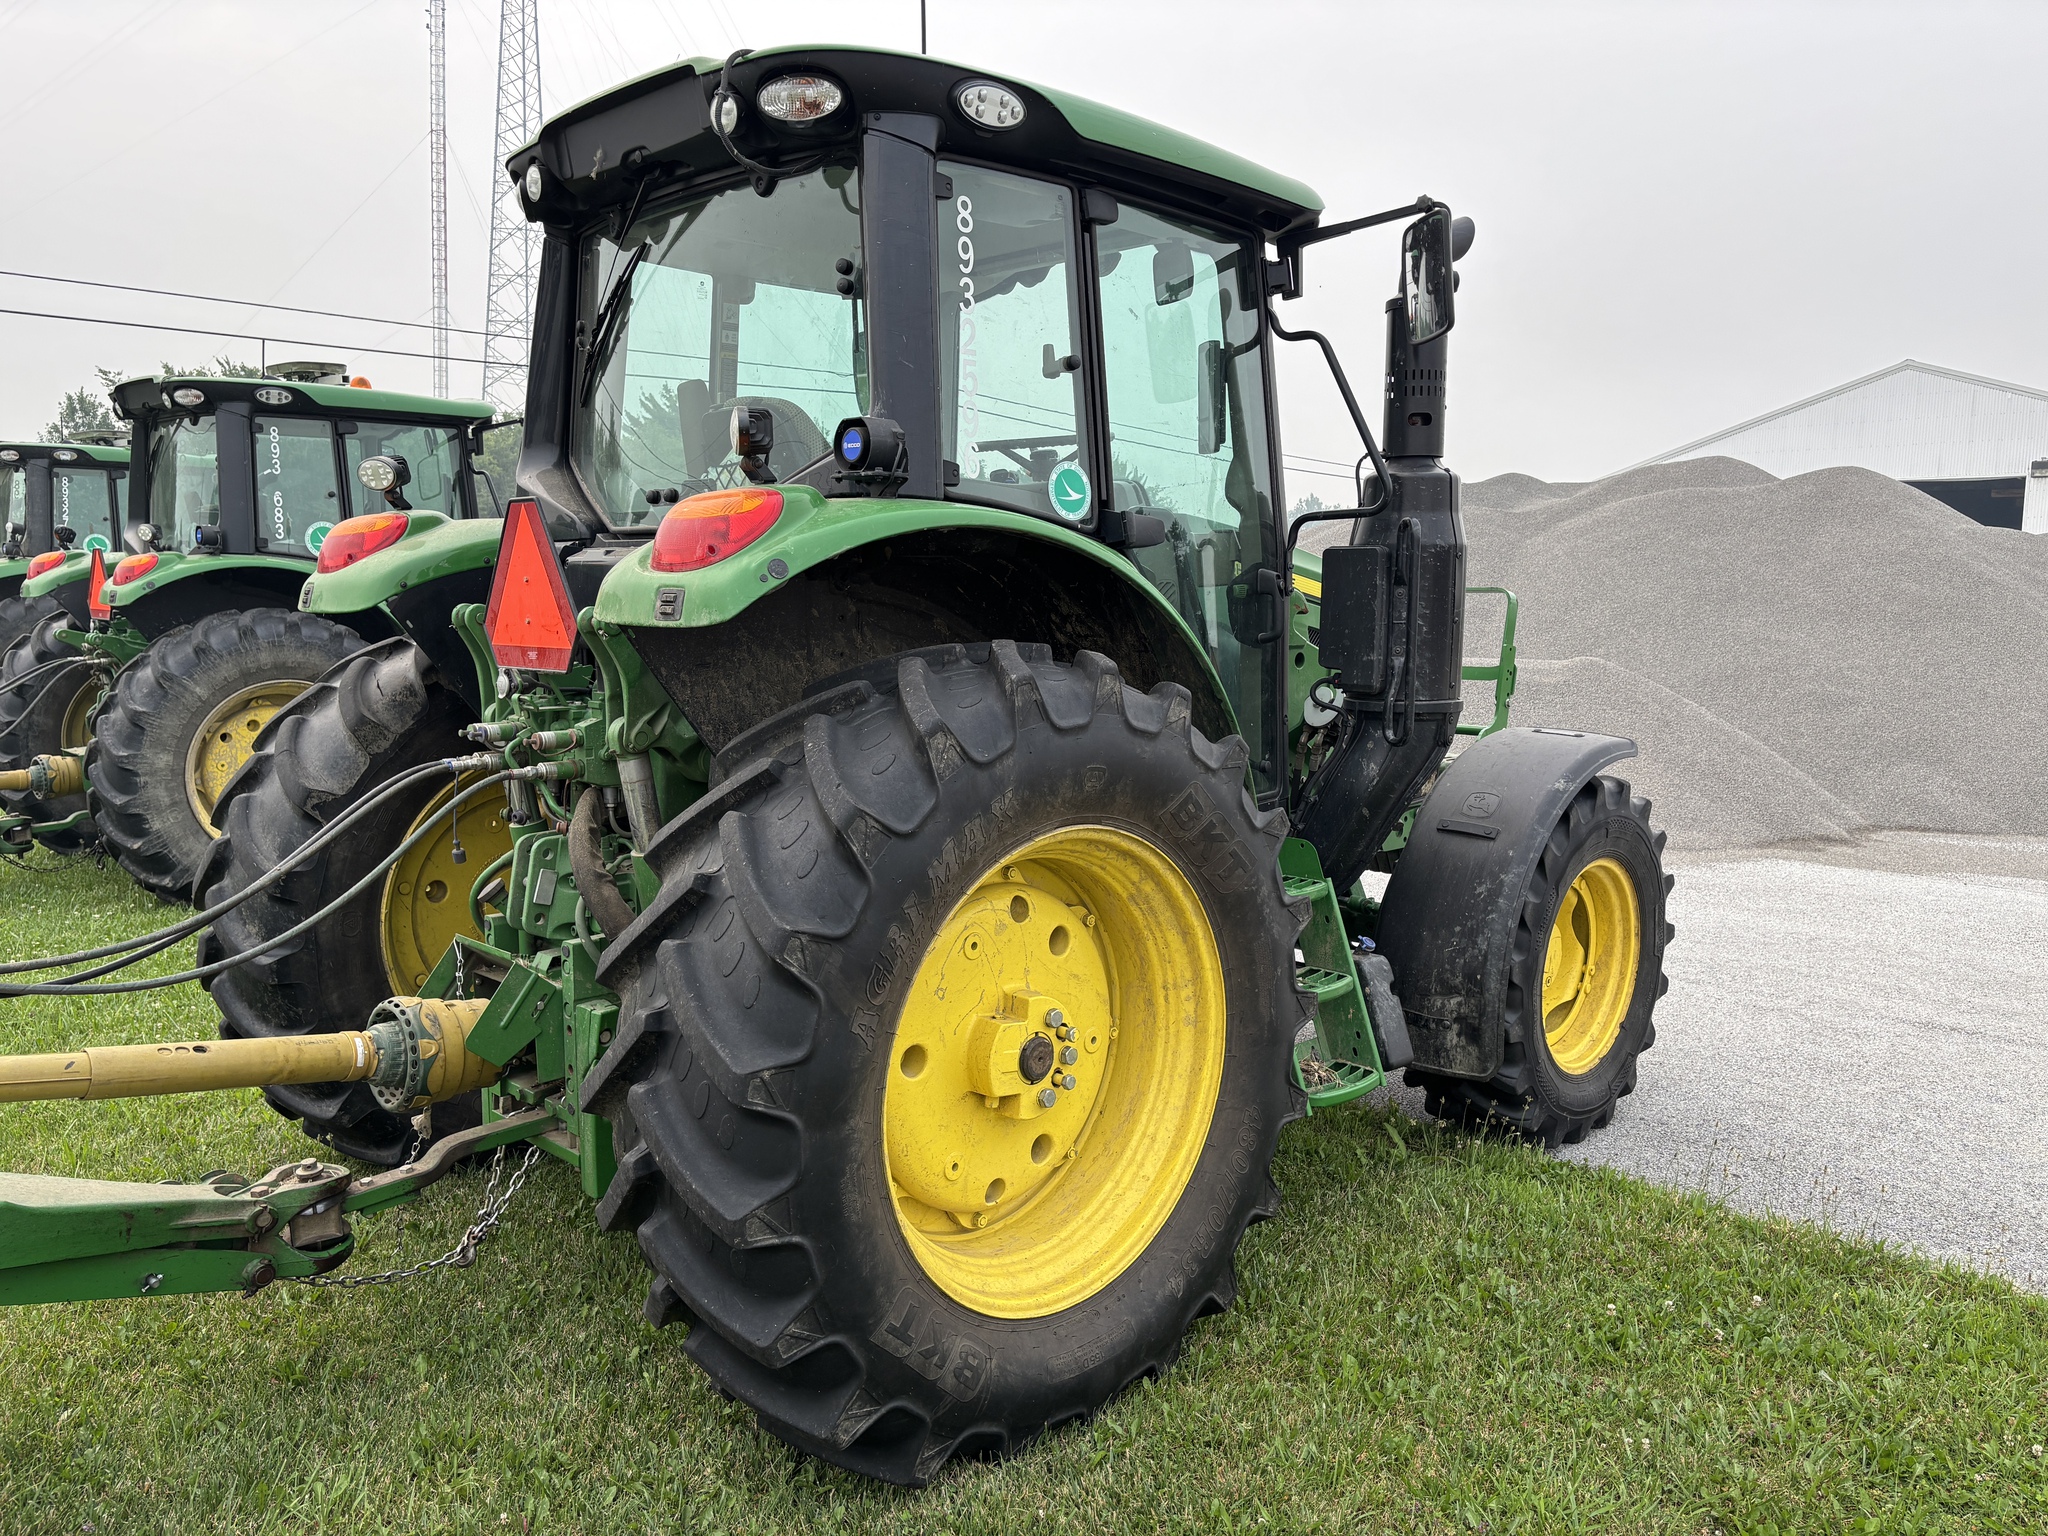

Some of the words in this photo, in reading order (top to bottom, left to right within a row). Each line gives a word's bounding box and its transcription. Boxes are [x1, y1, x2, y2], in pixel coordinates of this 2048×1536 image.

[957, 195, 981, 479] 8932596
[1166, 785, 1255, 887] BKT
[879, 1298, 990, 1395] BKT
